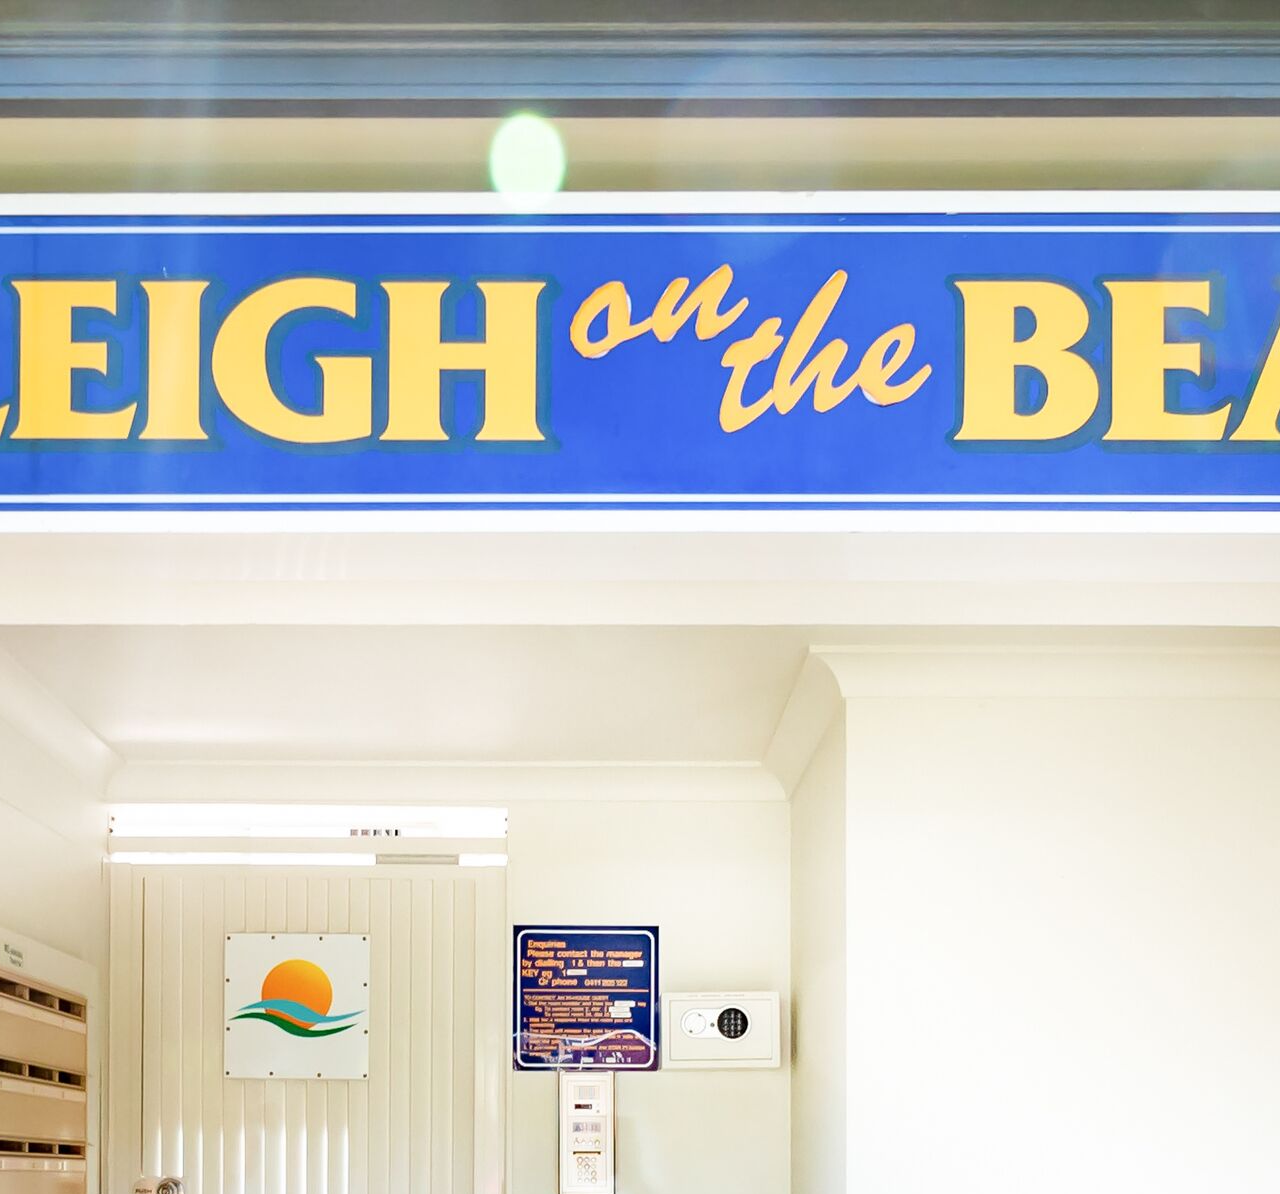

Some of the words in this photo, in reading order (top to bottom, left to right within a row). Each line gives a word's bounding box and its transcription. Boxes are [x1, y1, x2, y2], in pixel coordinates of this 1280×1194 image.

[569, 264, 748, 360] on
[720, 269, 931, 434] the
[557, 950, 588, 958] contact
